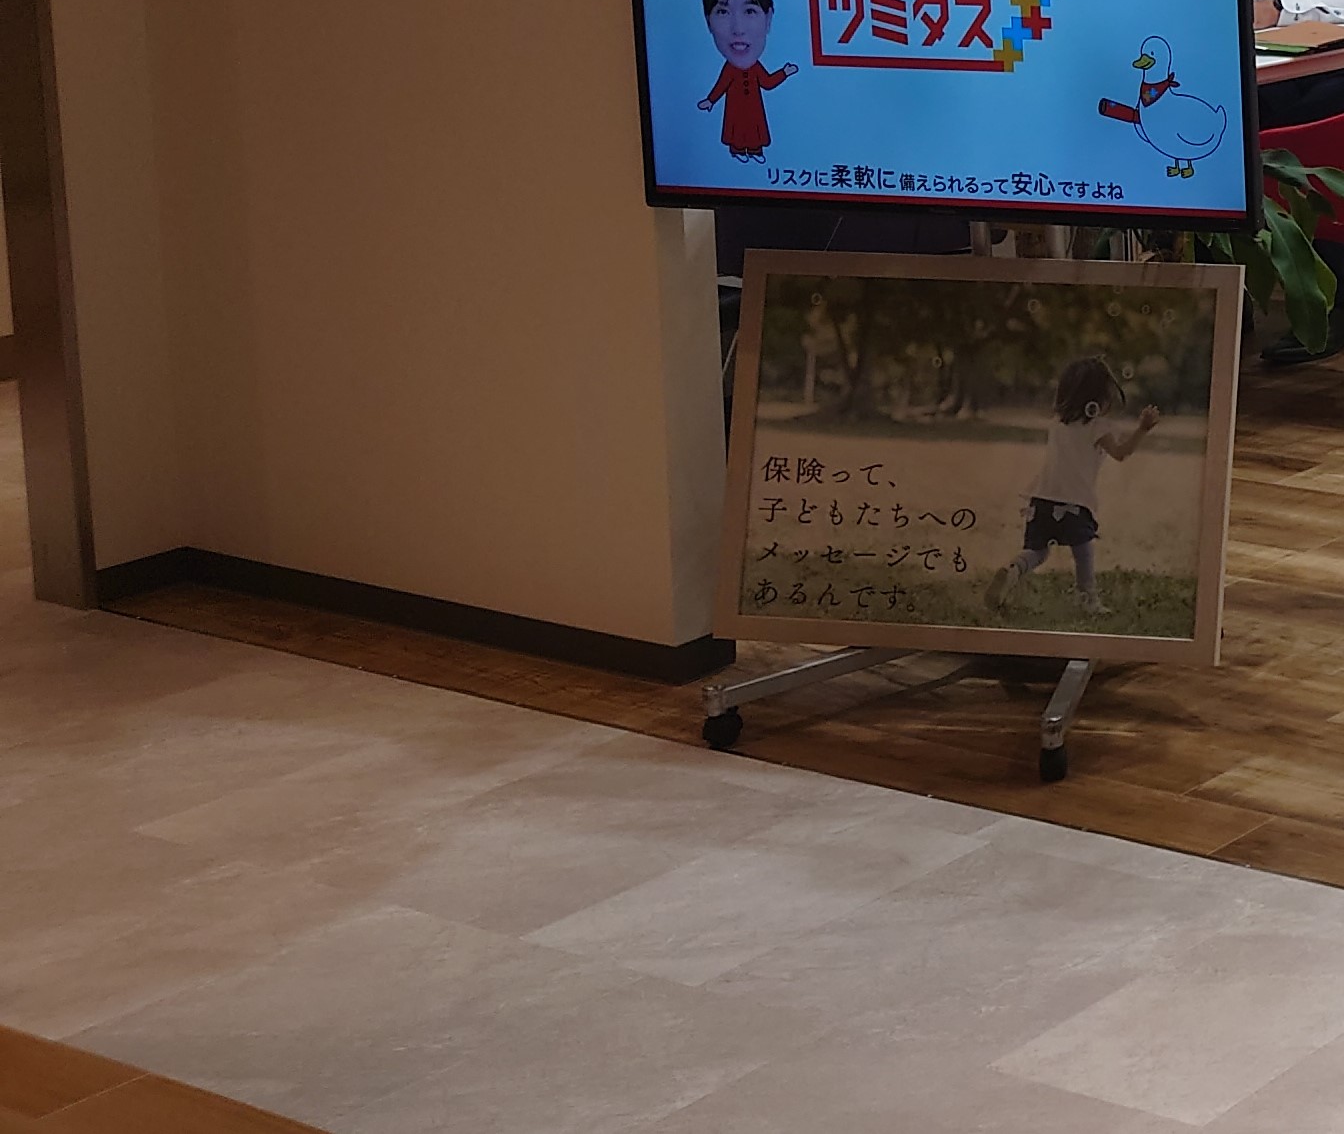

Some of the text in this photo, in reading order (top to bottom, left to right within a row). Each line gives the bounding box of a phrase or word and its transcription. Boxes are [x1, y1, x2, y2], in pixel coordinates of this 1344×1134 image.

[761, 456, 898, 489] 保険って、
[757, 497, 977, 532] 子どもたちへの
[755, 541, 970, 573] メッセージでも
[753, 578, 920, 614] あるんです。
